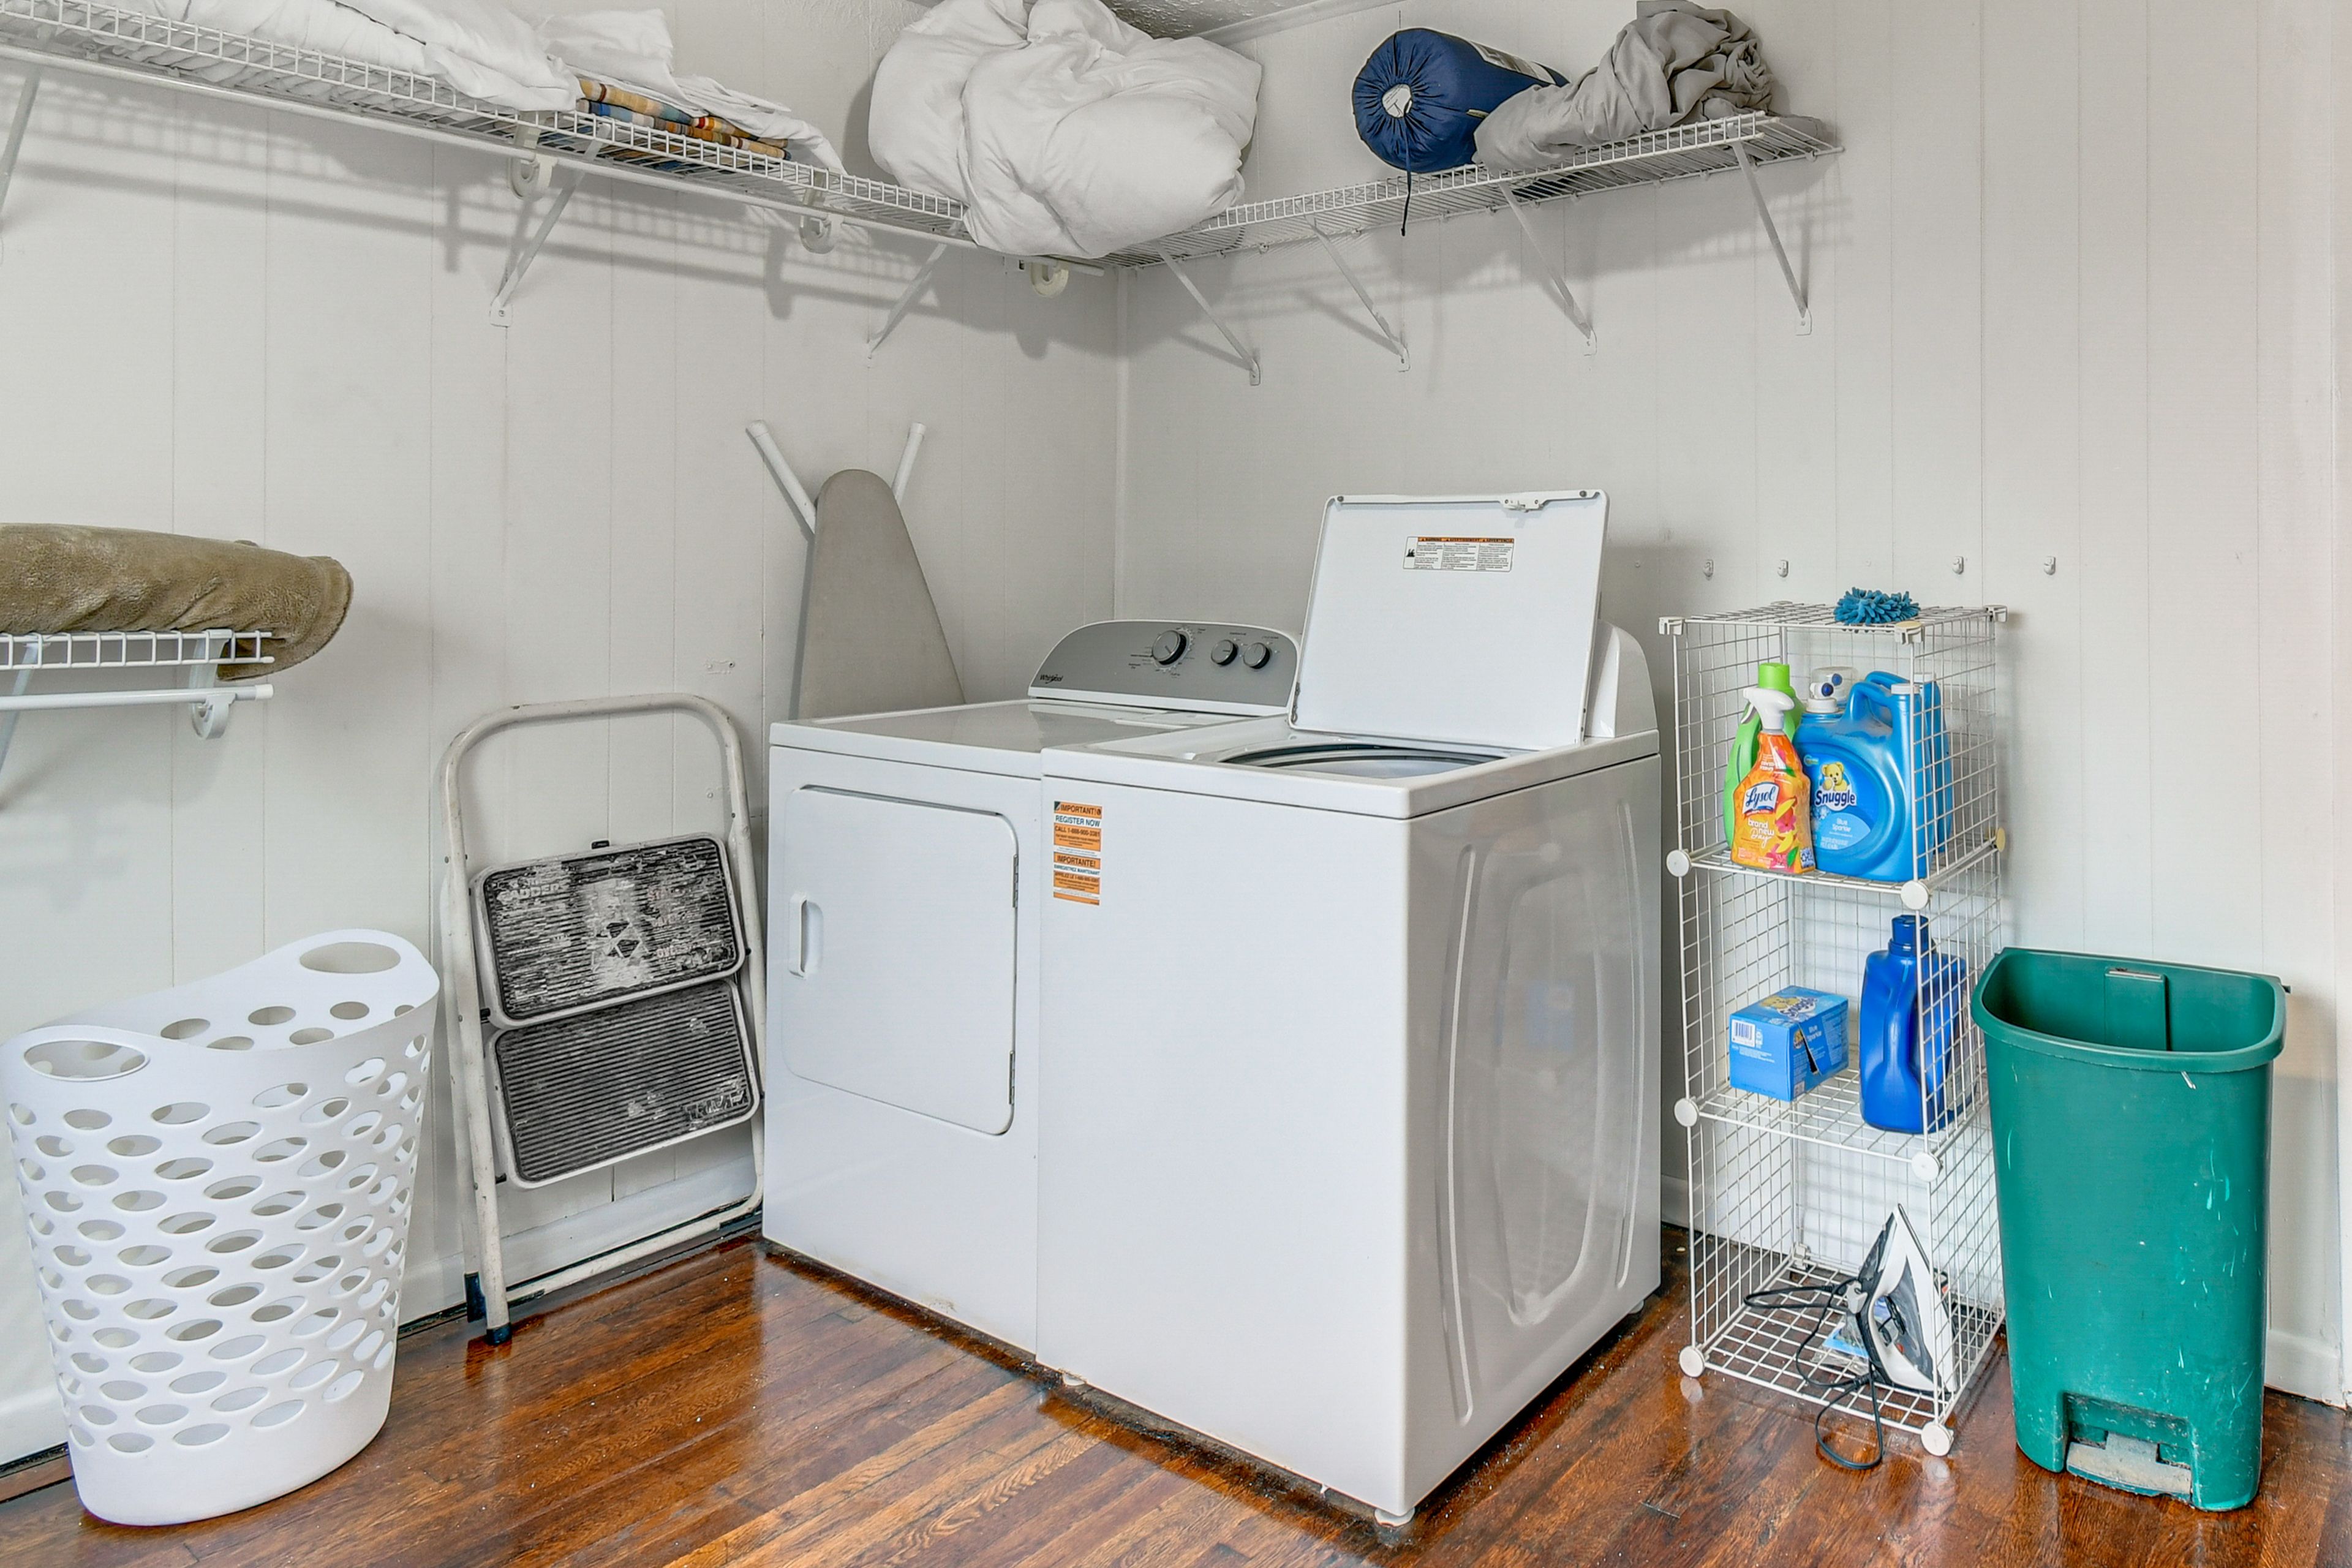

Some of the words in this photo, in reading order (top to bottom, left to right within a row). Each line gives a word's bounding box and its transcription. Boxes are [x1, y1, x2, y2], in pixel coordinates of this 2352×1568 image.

[1746, 786, 1776, 809] Lysol
[1815, 790, 1855, 807] Snuggle
[1055, 815, 1085, 825] REGISTER
[1748, 818, 1768, 829] brand
